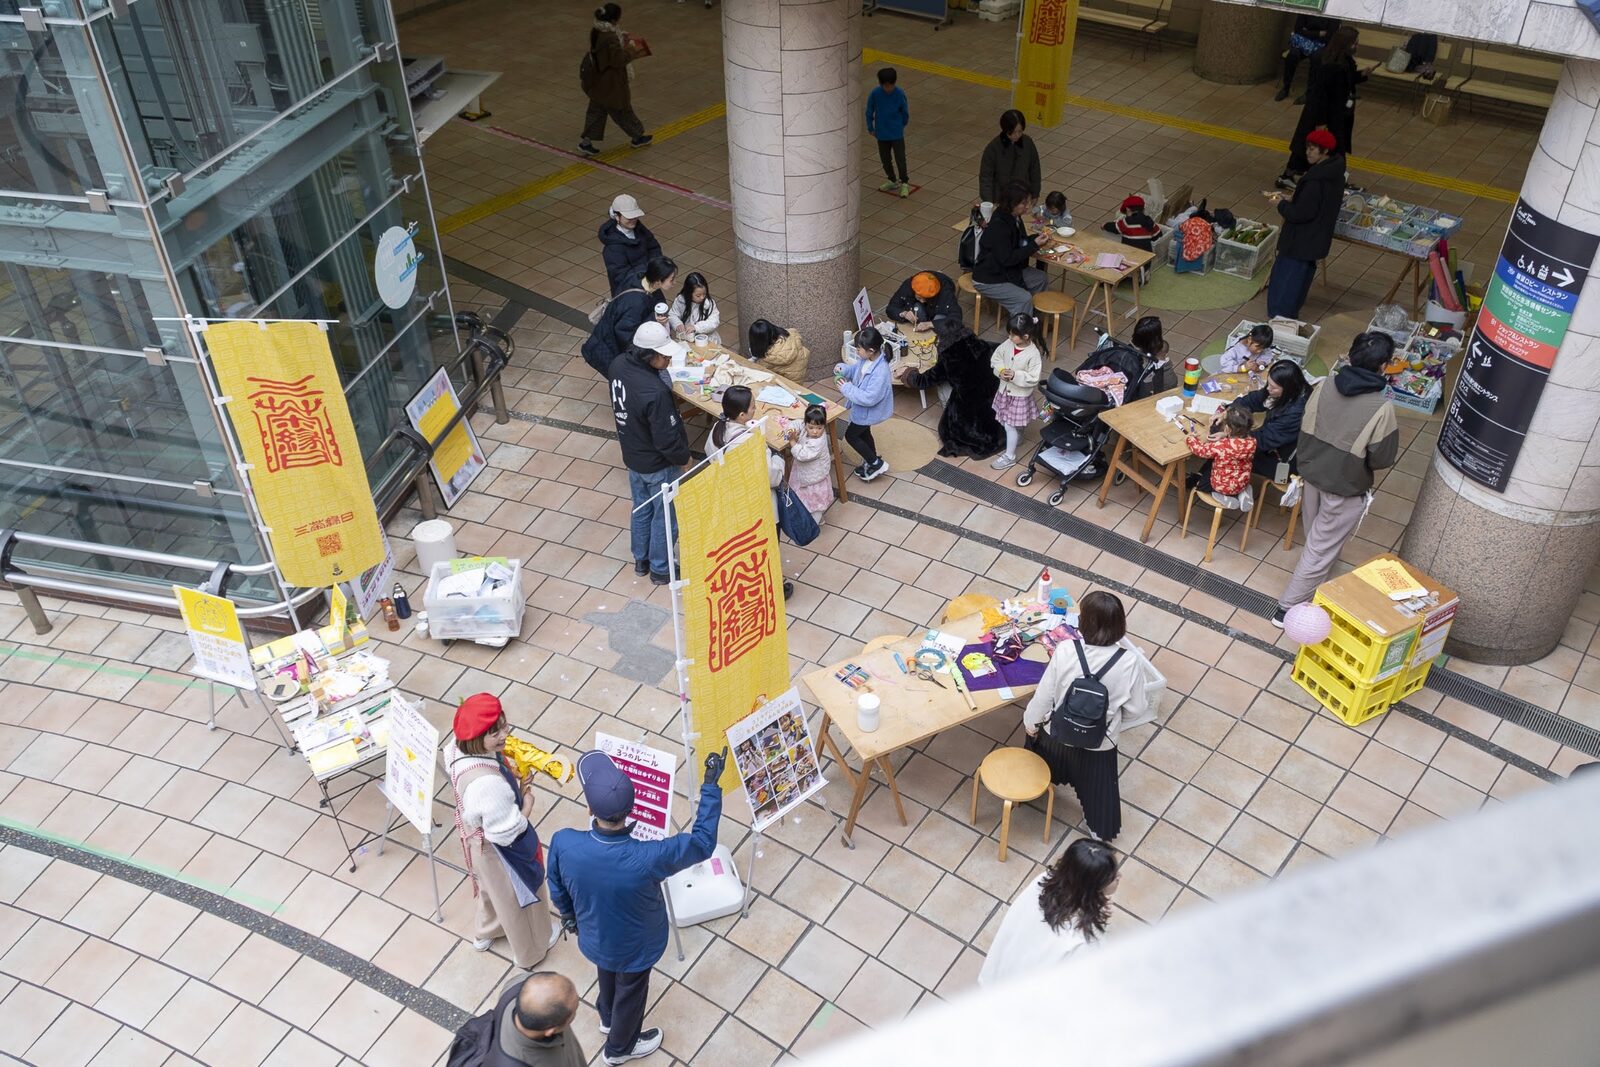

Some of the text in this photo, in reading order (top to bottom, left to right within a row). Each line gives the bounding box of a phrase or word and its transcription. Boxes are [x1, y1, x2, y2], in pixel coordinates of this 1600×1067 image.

[1541, 286, 1568, 300] レストラン
[617, 749, 658, 767] 3つのルール
